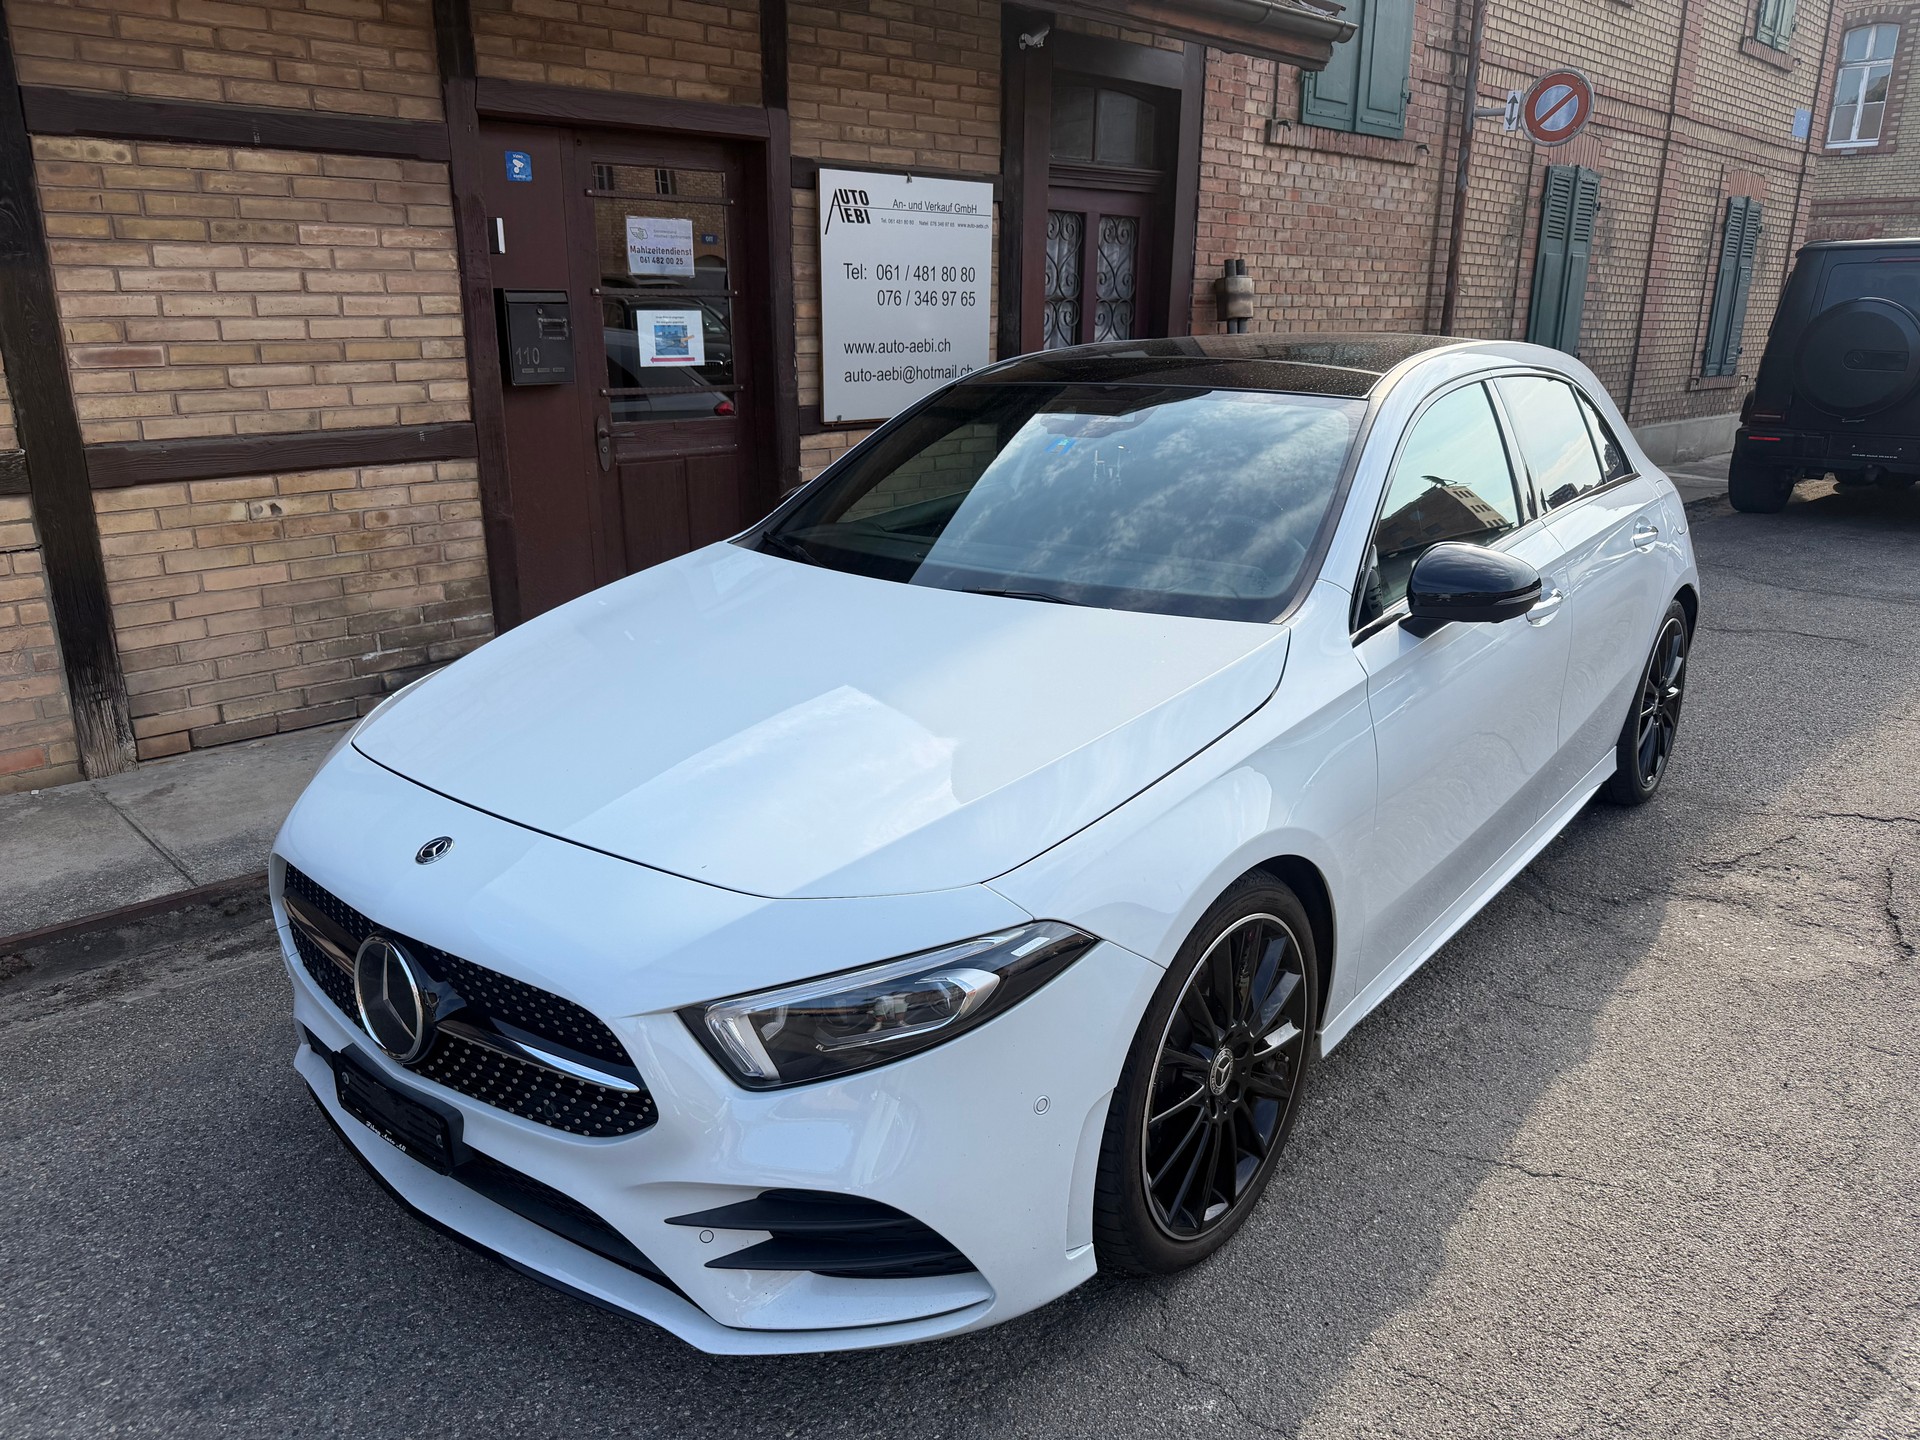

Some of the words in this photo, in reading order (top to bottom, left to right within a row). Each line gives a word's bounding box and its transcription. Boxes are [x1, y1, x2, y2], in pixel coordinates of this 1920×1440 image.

[892, 198, 906, 209] An-
[908, 200, 922, 210] und
[924, 200, 953, 213] Verkauf
[954, 203, 977, 214] GmbH
[629, 245, 693, 256] Mahlzeitendienst
[639, 256, 651, 264] 061
[651, 256, 664, 265] 482
[665, 257, 674, 265] 00
[675, 257, 684, 265] 25
[843, 262, 867, 280] Tel:
[876, 264, 900, 281] 061
[904, 264, 910, 281] /
[913, 265, 936, 282] 481
[941, 266, 957, 282] 80
[960, 266, 976, 283] 80
[877, 289, 902, 306] 076
[905, 289, 911, 307] /
[914, 290, 938, 307] 346
[941, 290, 957, 307] 97
[960, 290, 976, 307] 65
[843, 338, 951, 354] www.auto-aebi.ch
[515, 346, 540, 365] 110
[844, 364, 973, 384] auto-aebi@hotmail.ch
